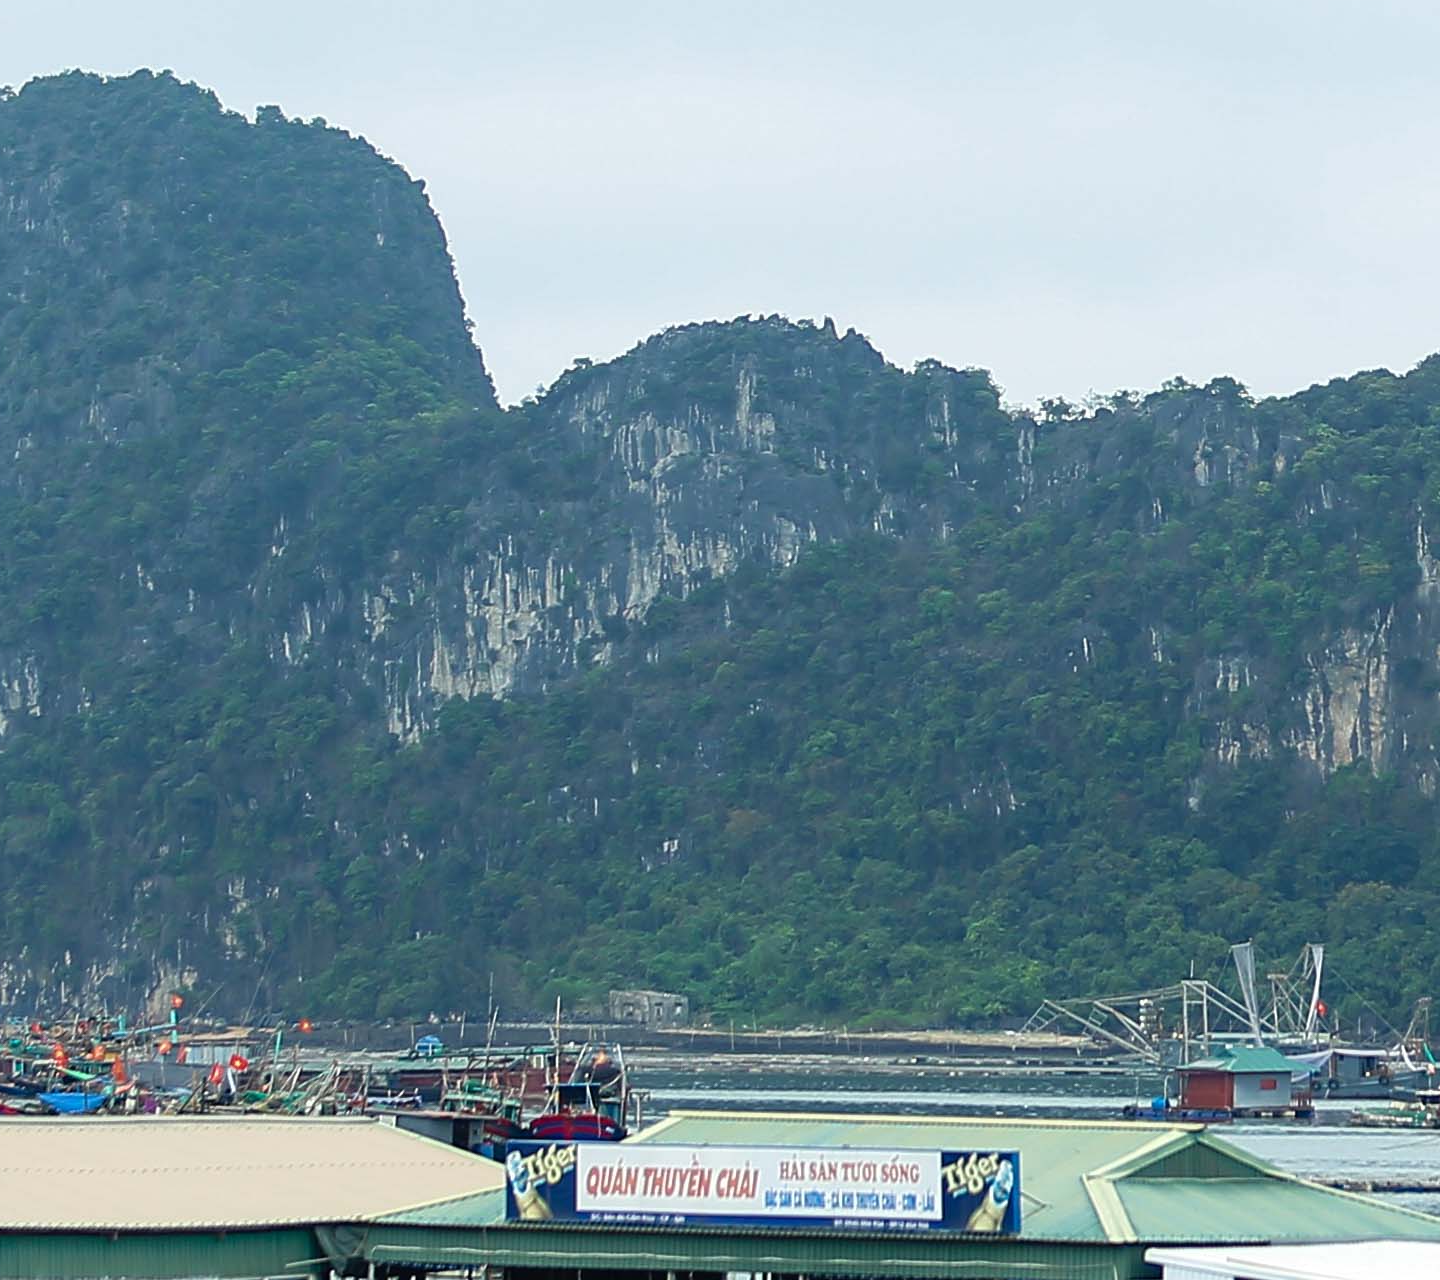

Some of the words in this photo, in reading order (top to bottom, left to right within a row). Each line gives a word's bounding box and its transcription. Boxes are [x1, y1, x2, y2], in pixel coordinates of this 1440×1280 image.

[521, 1144, 577, 1184] Tiger
[586, 1157, 639, 1198] QUÁN
[643, 1151, 711, 1198] THUYỀN
[779, 1153, 805, 1181] HẢI
[810, 1154, 838, 1182] SẢN
[841, 1160, 877, 1182] TƯƠI
[881, 1155, 920, 1183] SỐNG
[942, 1152, 999, 1195] Tiger
